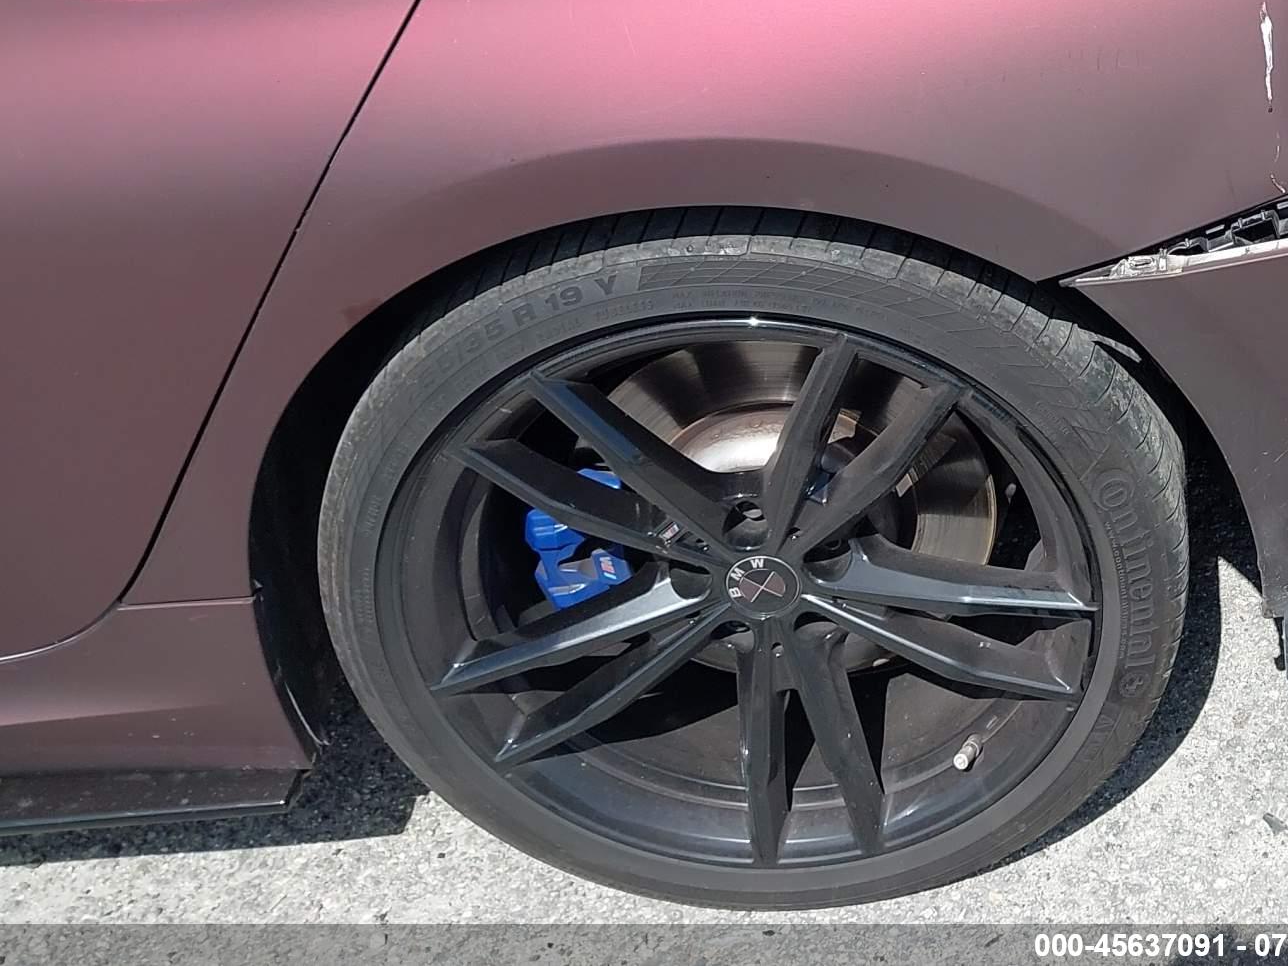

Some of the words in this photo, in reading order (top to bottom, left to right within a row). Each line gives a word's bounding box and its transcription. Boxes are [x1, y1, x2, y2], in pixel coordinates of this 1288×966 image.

[511, 301, 538, 328] R
[544, 285, 584, 312] 19
[594, 274, 617, 297] Y
[728, 558, 765, 599] BMW
[1091, 467, 1160, 668] Continental
